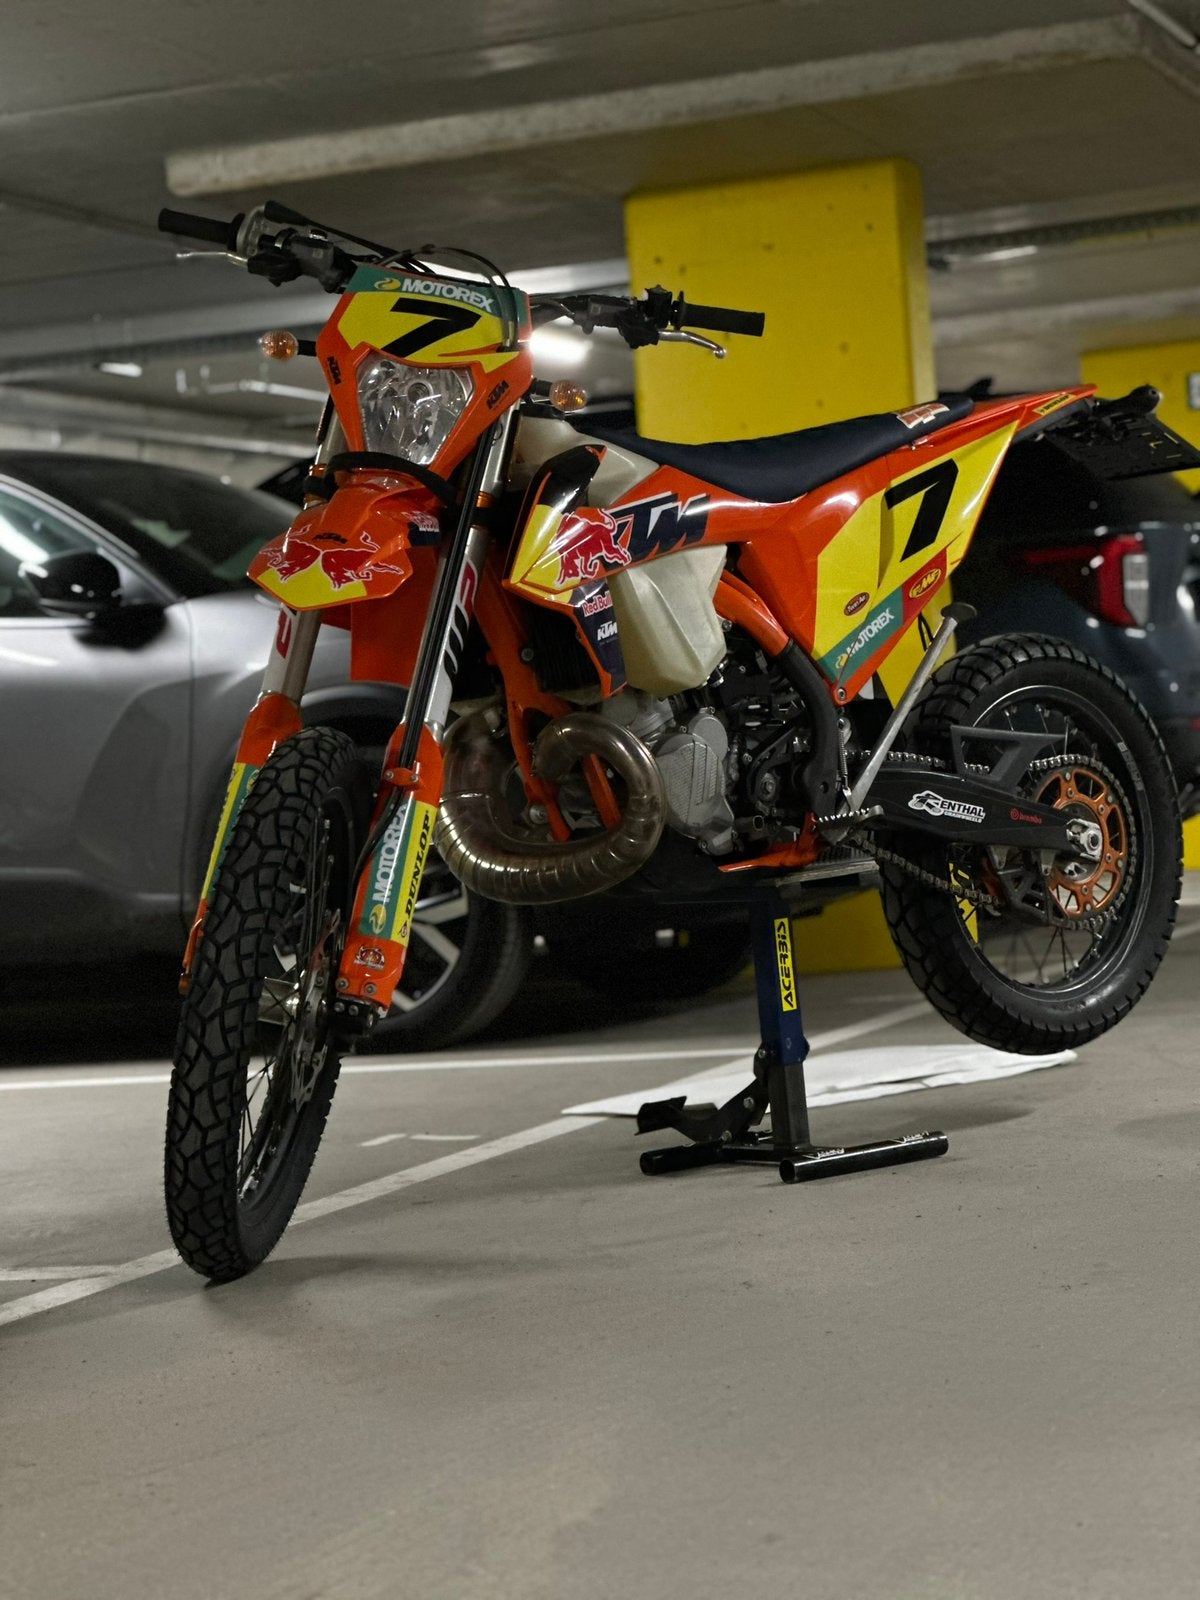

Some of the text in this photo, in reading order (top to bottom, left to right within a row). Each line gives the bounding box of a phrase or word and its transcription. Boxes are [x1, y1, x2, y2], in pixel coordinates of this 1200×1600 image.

[401, 278, 494, 313] MOTOREX
[380, 297, 482, 358] 7
[487, 380, 509, 410] KTM
[883, 458, 959, 562] 7
[597, 621, 618, 641] KTM
[845, 607, 895, 657] MOTOREX
[404, 814, 431, 918] DUNLOP
